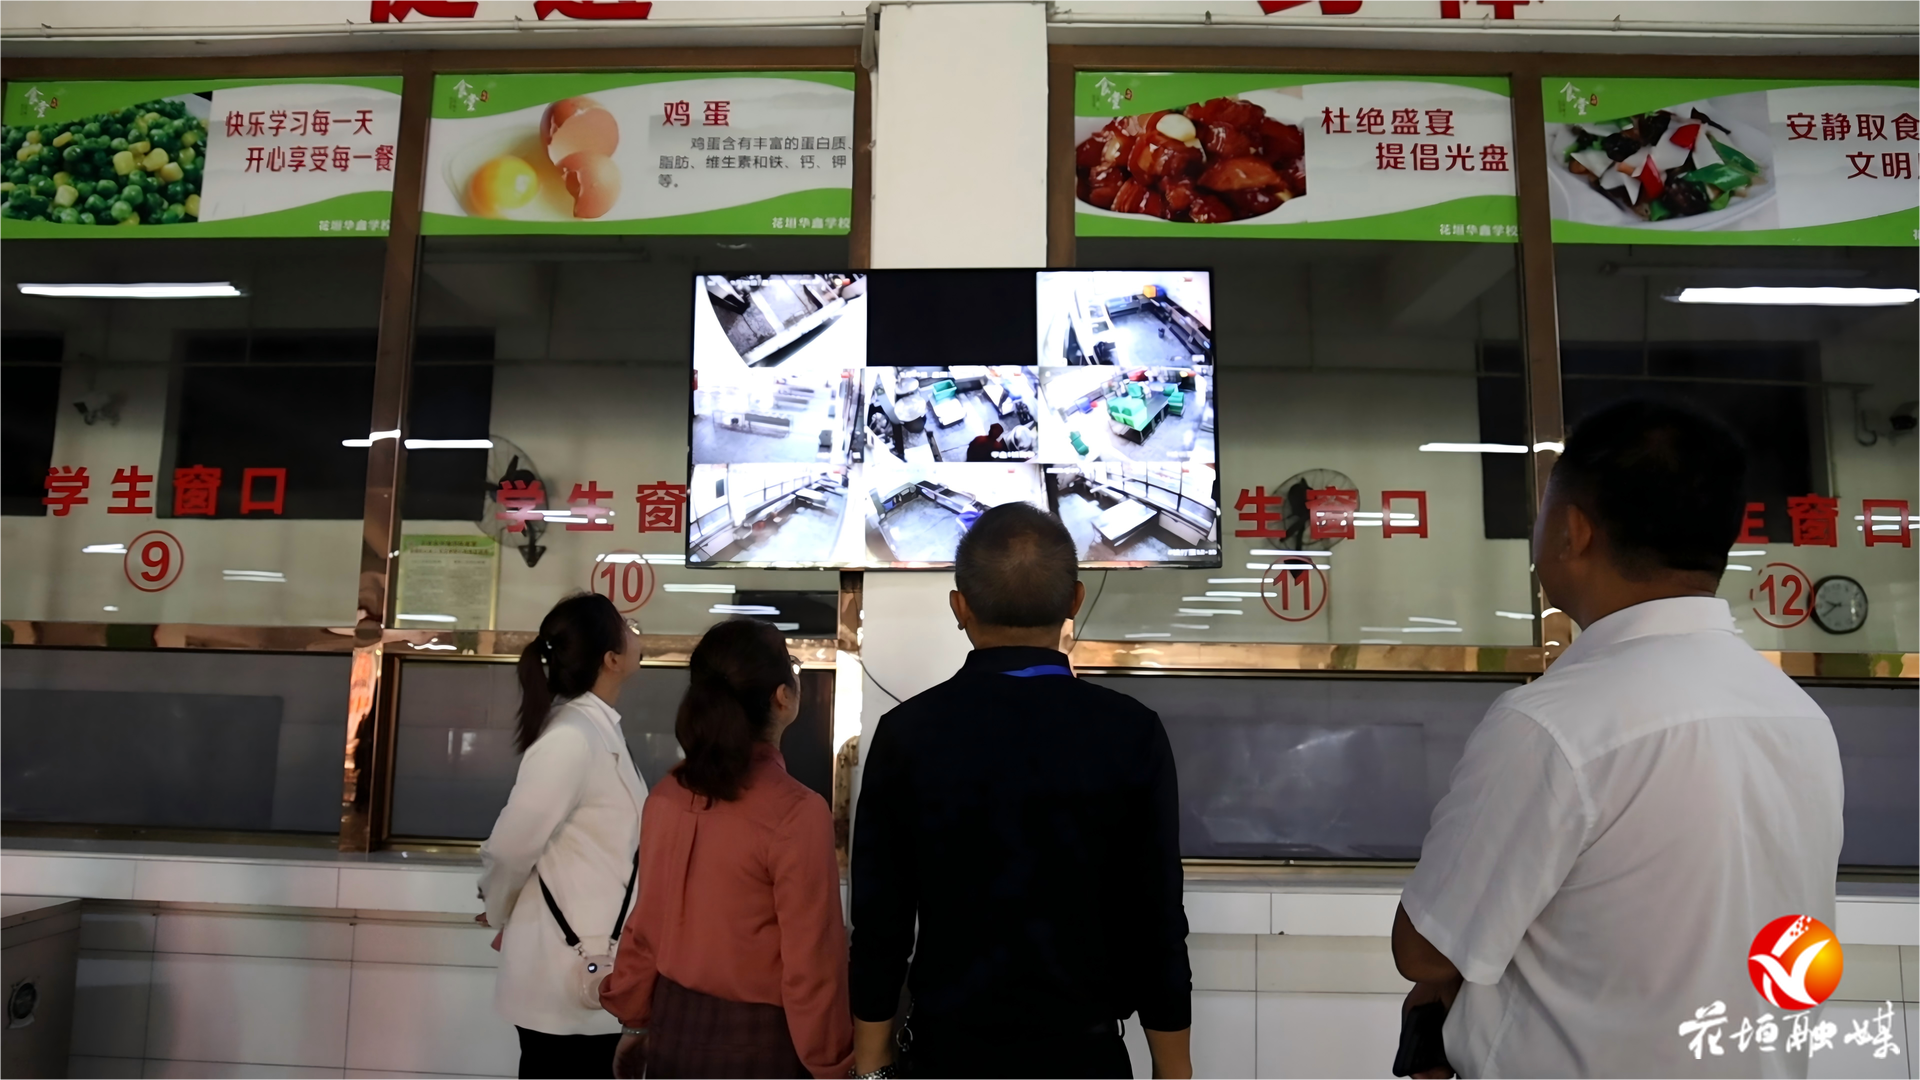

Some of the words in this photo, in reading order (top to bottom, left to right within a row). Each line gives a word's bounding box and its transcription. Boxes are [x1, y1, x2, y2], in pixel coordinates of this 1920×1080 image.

[225, 109, 373, 137] 快乐学习每一天
[662, 100, 731, 127] 鸡蛋
[1321, 107, 1455, 137] 杜绝盛宴
[1787, 112, 1920, 141] 安静取食
[244, 145, 394, 173] 开心享受每一餐
[1375, 142, 1510, 172] 提倡光盘
[1845, 151, 1920, 180] 文明
[658, 174, 679, 188] 等。
[42, 464, 287, 517] 学生窗口
[140, 540, 170, 582] 9
[600, 559, 643, 603] 10
[1272, 569, 1311, 611] 11
[1759, 574, 1804, 616] 12
